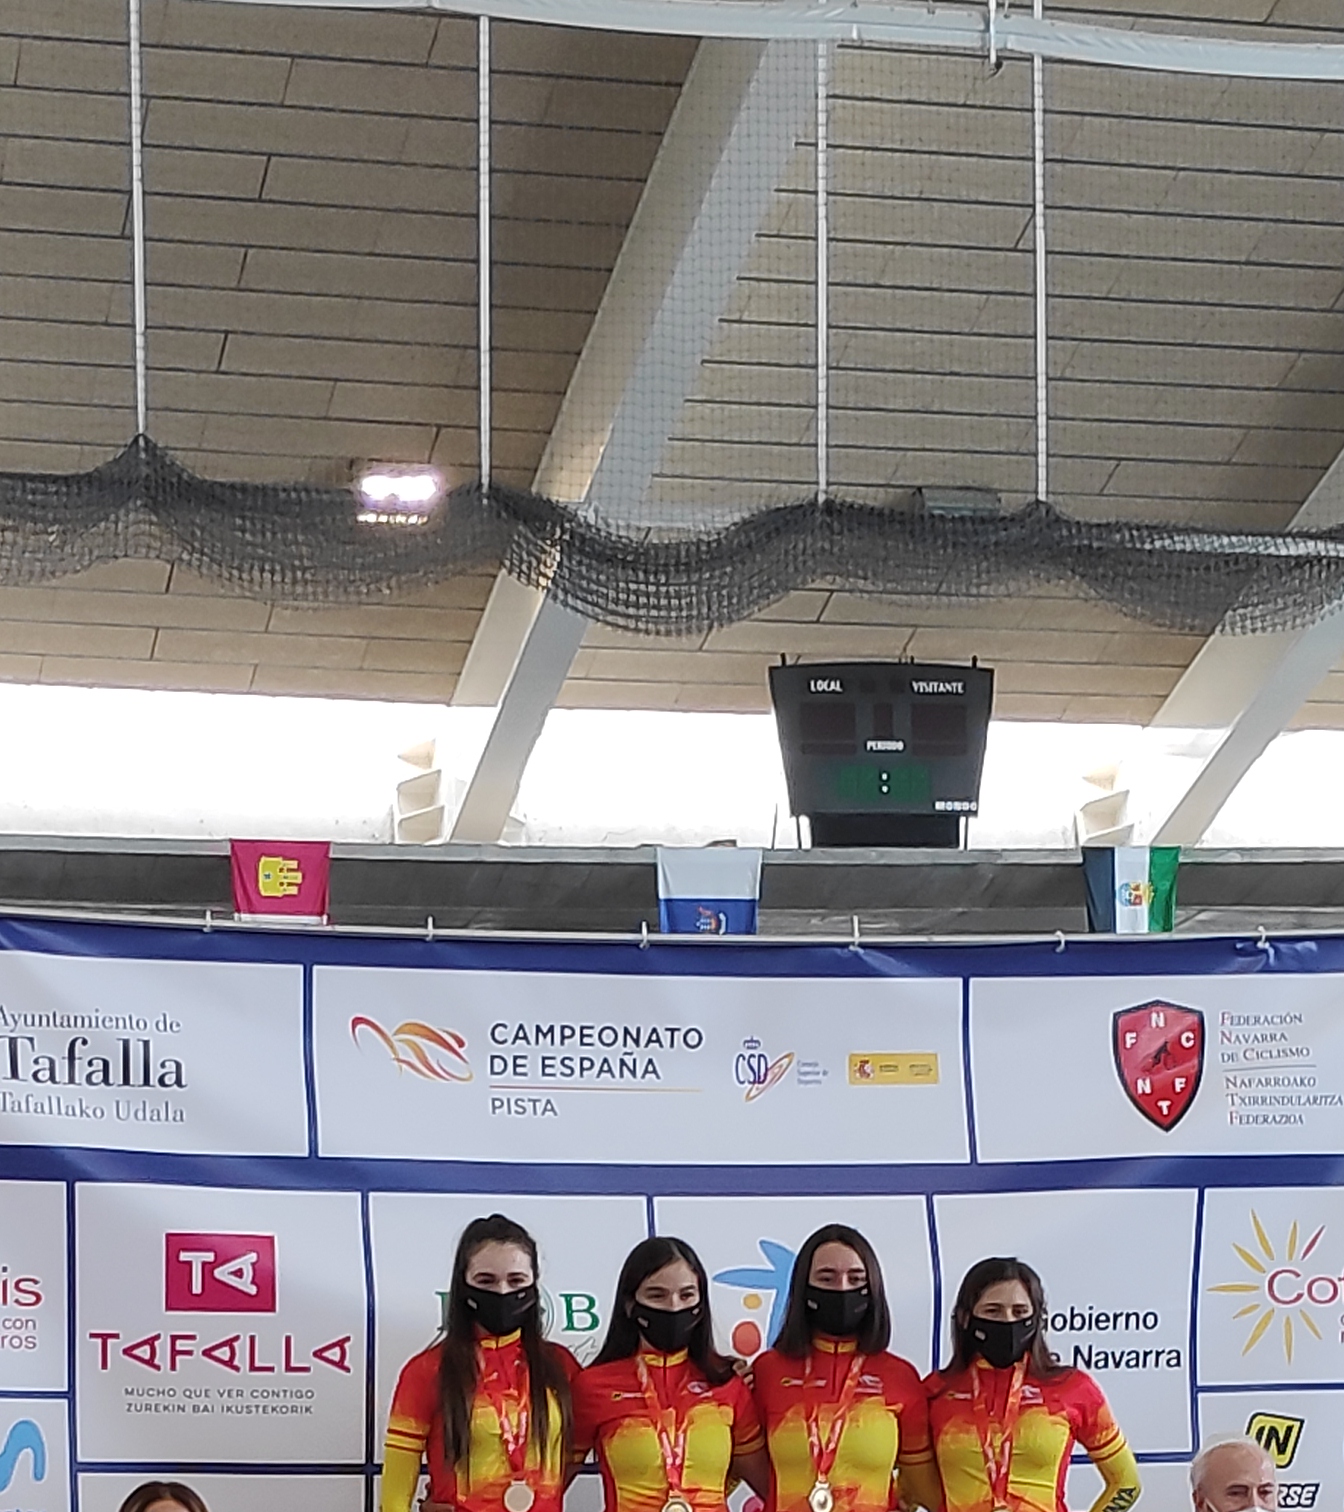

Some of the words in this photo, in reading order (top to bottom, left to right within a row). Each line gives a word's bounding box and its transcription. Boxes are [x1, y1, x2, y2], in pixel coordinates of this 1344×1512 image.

[810, 679, 843, 692] LOCAL
[912, 681, 964, 694] VISITANTE
[155, 1013, 181, 1033] de
[490, 1023, 703, 1049] CAMPEONATO
[490, 1055, 528, 1077] DE
[541, 1052, 661, 1080] ESPAÑA
[736, 1053, 768, 1084] CSD
[115, 1100, 185, 1123] Udala
[491, 1097, 558, 1116] PISTA
[2, 1316, 36, 1330] con
[89, 1332, 351, 1373] TAFALLA
[1072, 1345, 1182, 1370] Navarra
[124, 1387, 177, 1399] MUCHO
[183, 1388, 211, 1399] QUE
[217, 1389, 244, 1399] VER
[250, 1389, 315, 1400] CONTIGO
[126, 1402, 186, 1413] ZUREKIN
[192, 1403, 215, 1414] BAI
[221, 1404, 313, 1415] IKUSTEKORIK
